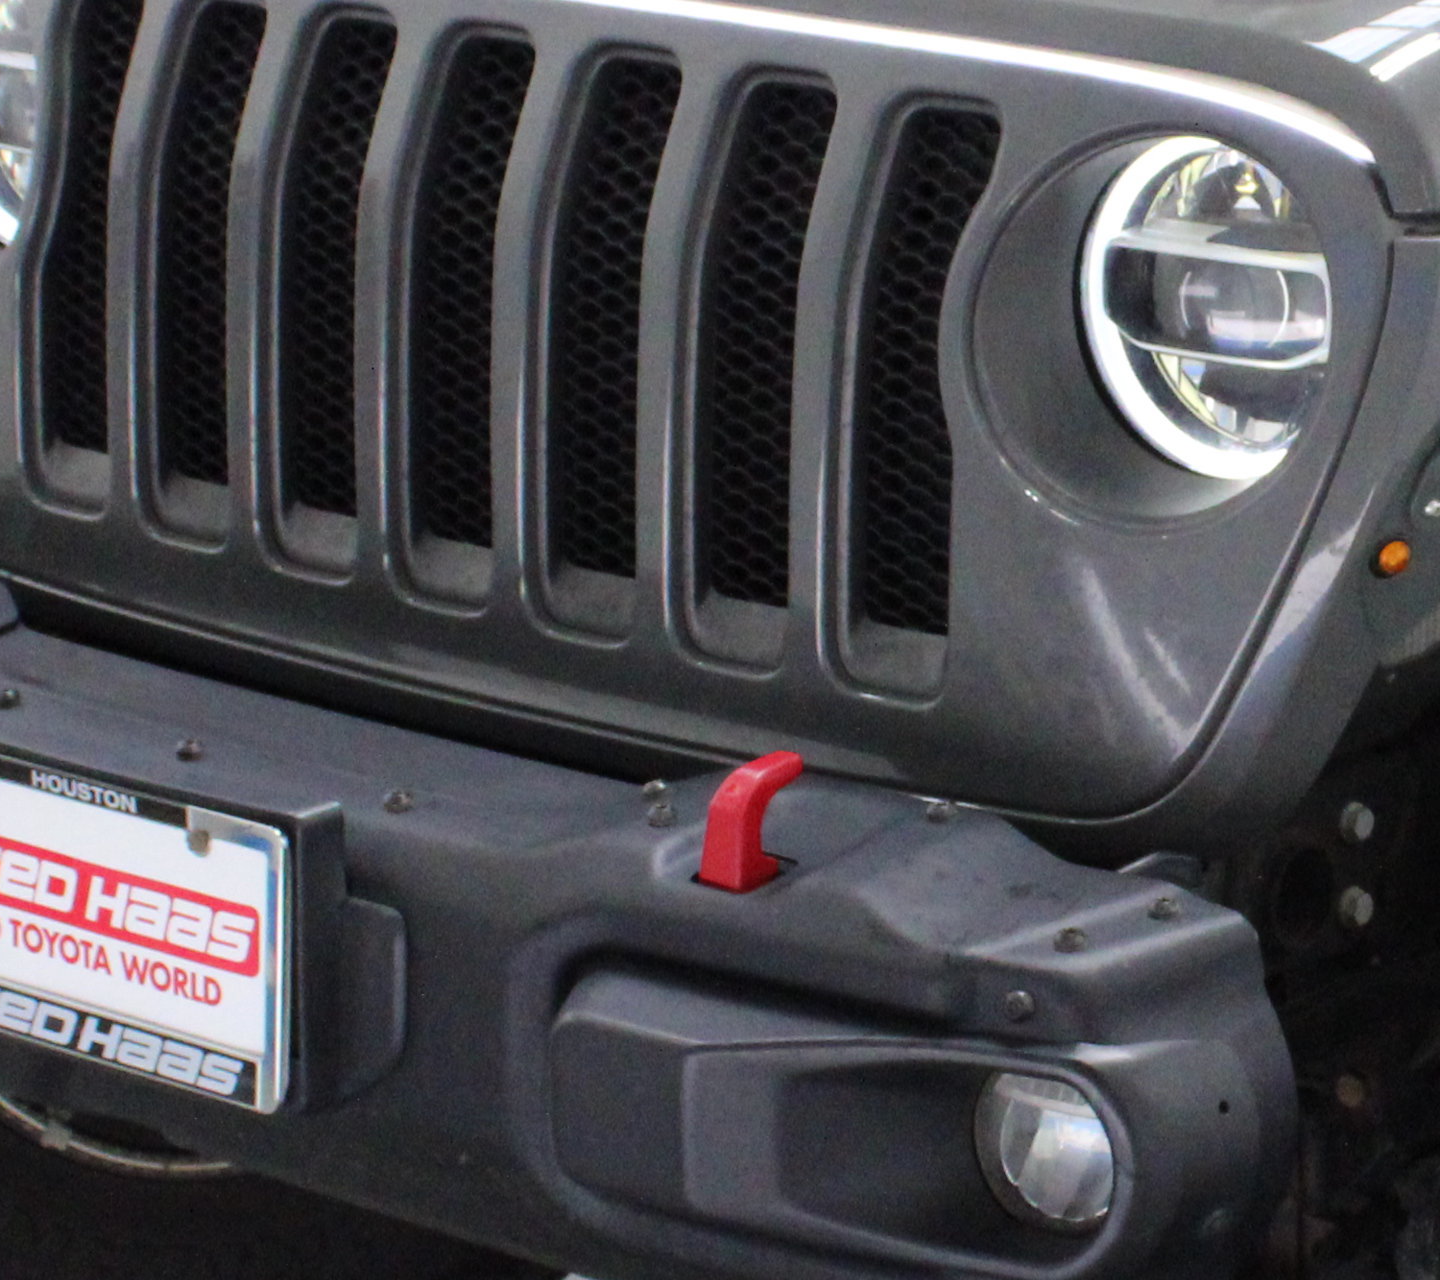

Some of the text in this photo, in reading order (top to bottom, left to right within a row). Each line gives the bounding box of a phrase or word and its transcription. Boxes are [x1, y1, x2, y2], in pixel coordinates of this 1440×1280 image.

[31, 769, 138, 814] HOUSTON
[9, 919, 222, 1006] TOYOTA WORLD
